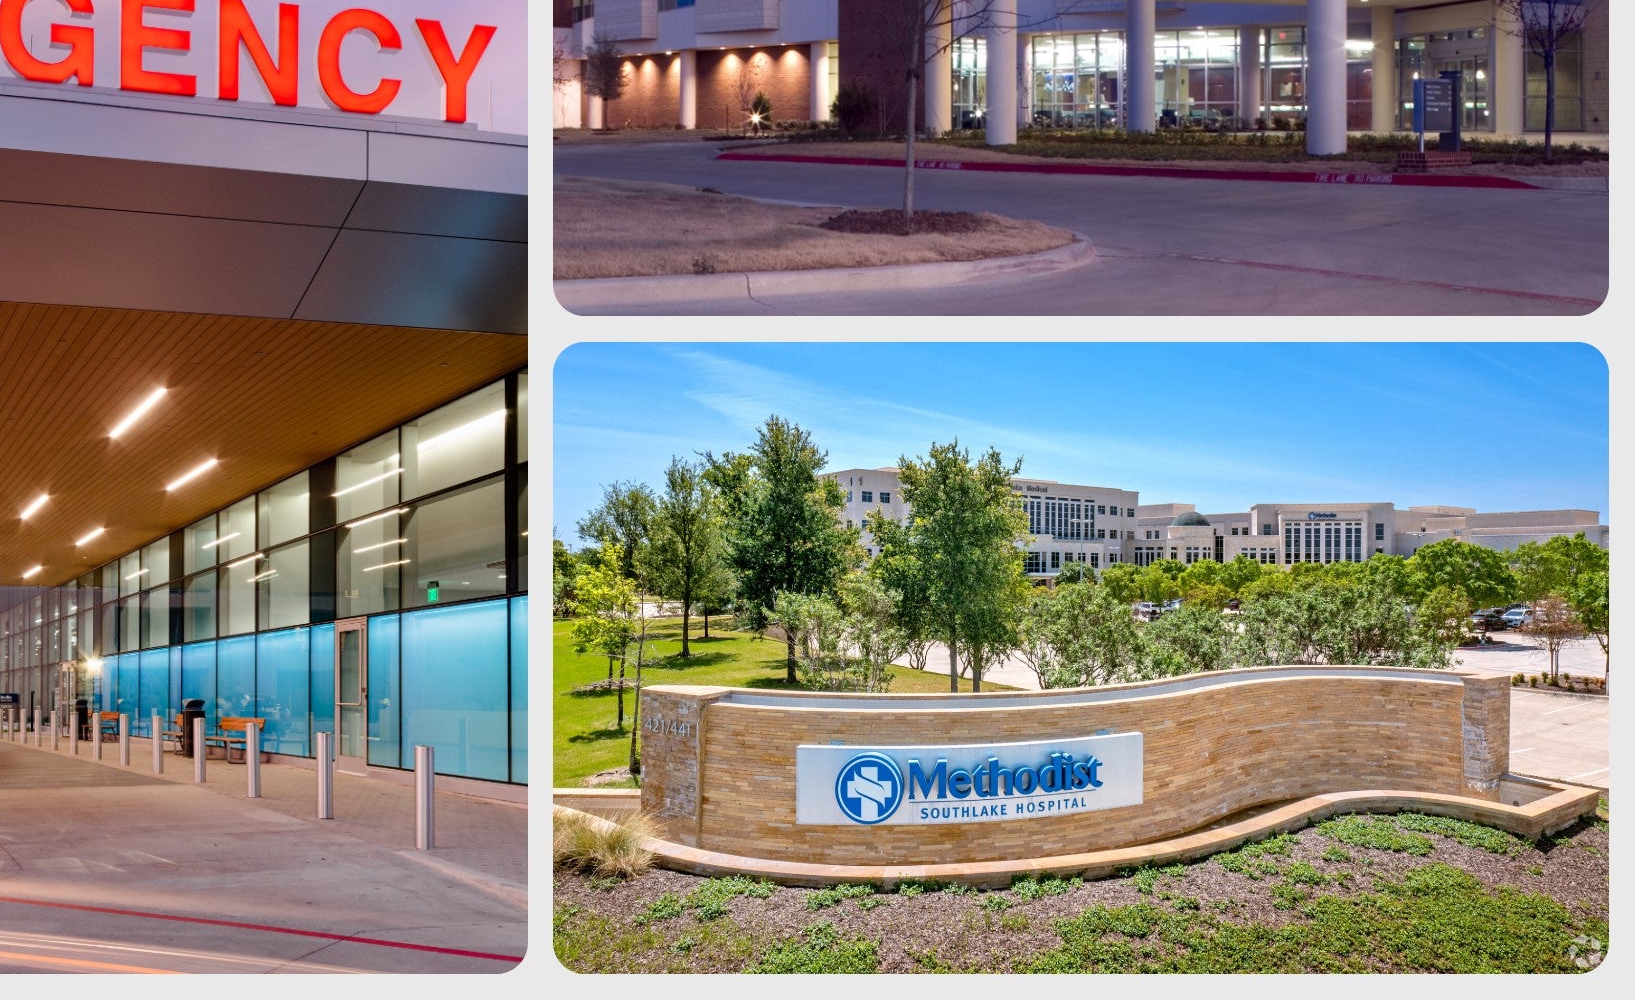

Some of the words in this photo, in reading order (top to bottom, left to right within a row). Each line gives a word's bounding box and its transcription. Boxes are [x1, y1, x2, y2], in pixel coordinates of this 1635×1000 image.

[1331, 173, 1349, 183] LANE
[645, 717, 691, 737] 421/441
[908, 752, 1104, 800] Methodist
[920, 804, 1007, 819] SOUTHLAKE
[1016, 797, 1087, 814] HOSPITAL
